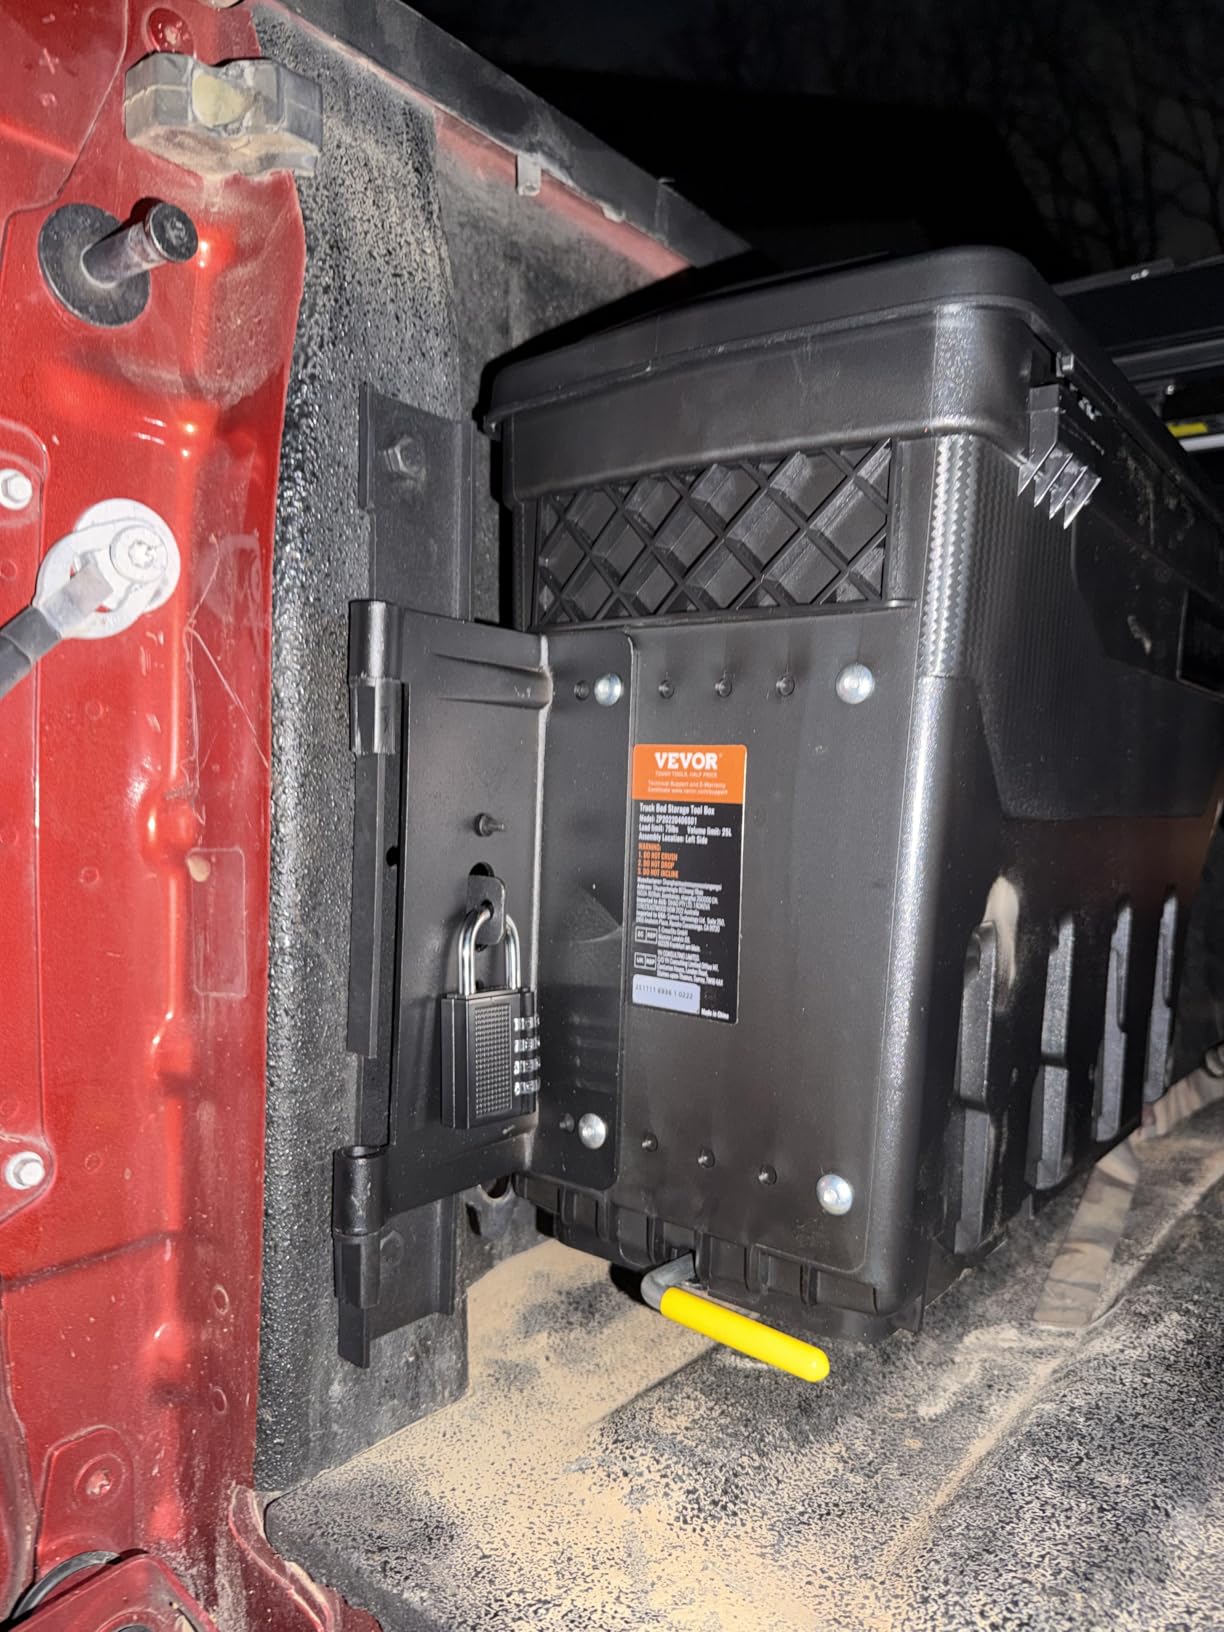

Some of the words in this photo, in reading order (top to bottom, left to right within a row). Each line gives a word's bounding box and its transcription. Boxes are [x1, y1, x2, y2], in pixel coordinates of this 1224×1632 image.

[654, 752, 718, 770] VEVOR
[640, 802, 655, 813] Truck
[656, 803, 667, 813] Bed
[668, 804, 690, 815] Storage
[691, 805, 702, 815] Tool
[704, 806, 715, 816] Box
[639, 823, 650, 832] Load
[687, 826, 706, 835] Volume
[639, 832, 661, 842] Assembly
[685, 834, 696, 844] Left
[696, 835, 708, 845] Side
[651, 851, 660, 860] NOT
[651, 860, 660, 868] NOT
[650, 868, 660, 876] NOT
[679, 990, 693, 1000] 0222
[701, 1008, 712, 1017] Made
[717, 1010, 730, 1020] China
